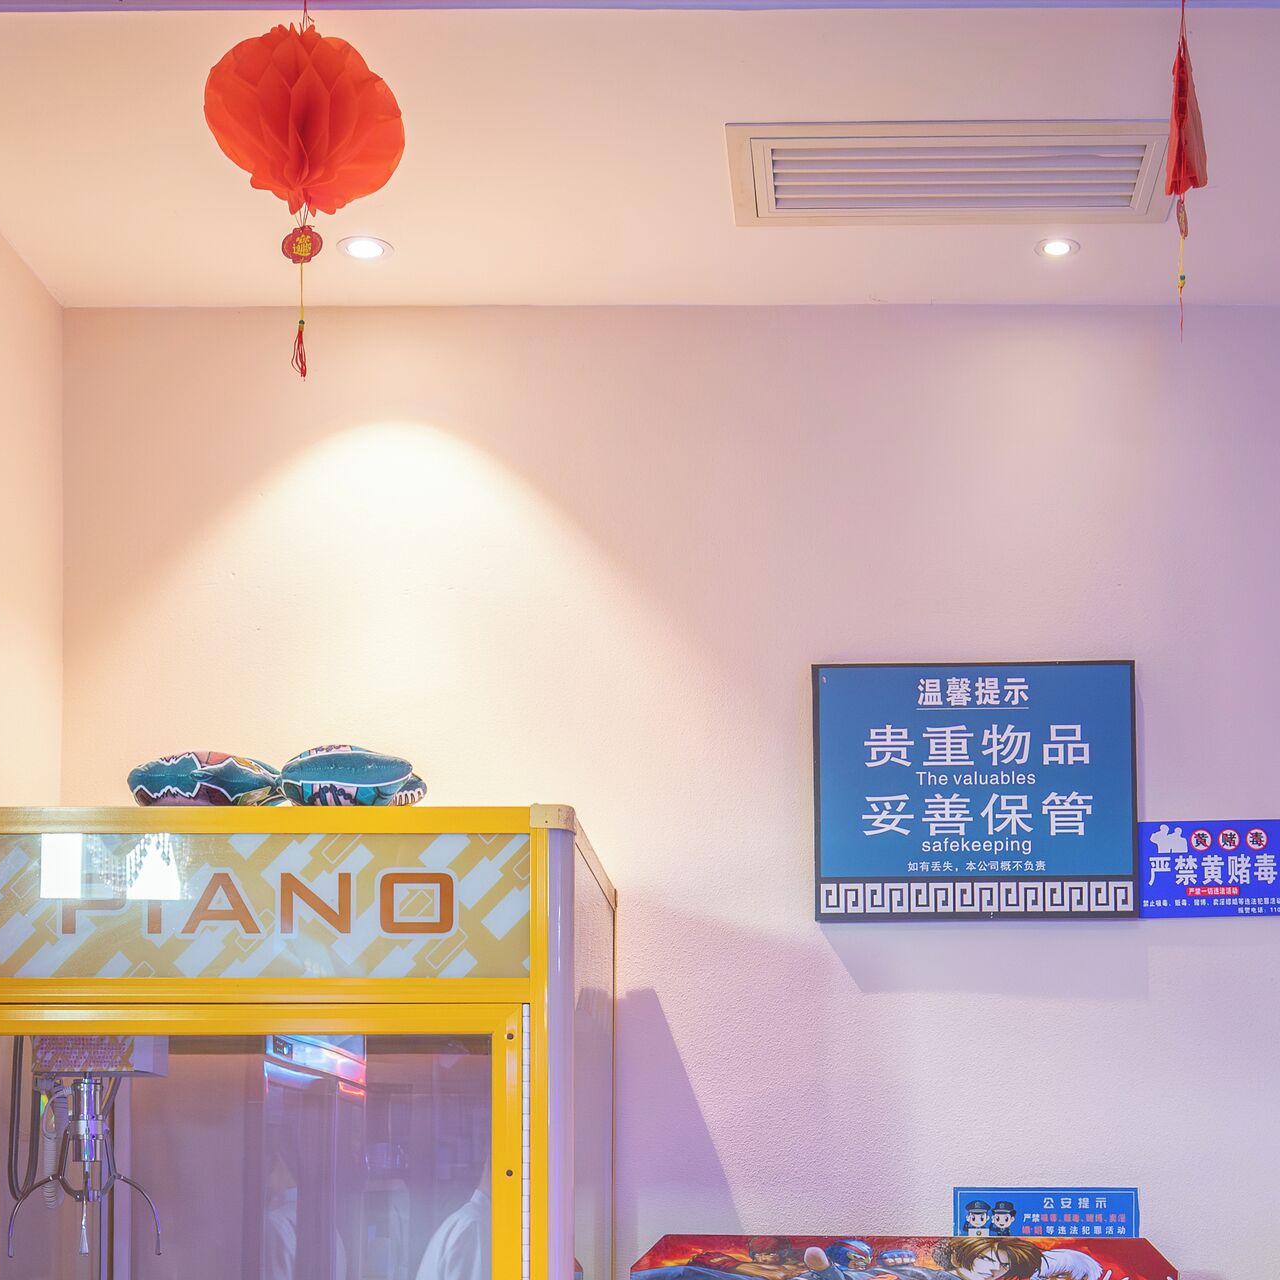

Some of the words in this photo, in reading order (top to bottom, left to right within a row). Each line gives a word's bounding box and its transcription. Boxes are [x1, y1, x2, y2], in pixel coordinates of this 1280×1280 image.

[863, 724, 1090, 767] 贵重物品
[916, 771, 948, 786] The
[953, 771, 1036, 785] valuables
[861, 791, 1093, 836] 妥善保管
[921, 837, 1032, 854] safekeeping
[1148, 853, 1278, 886] 严禁黄赌毒
[1043, 1197, 1108, 1209] 公安提示
